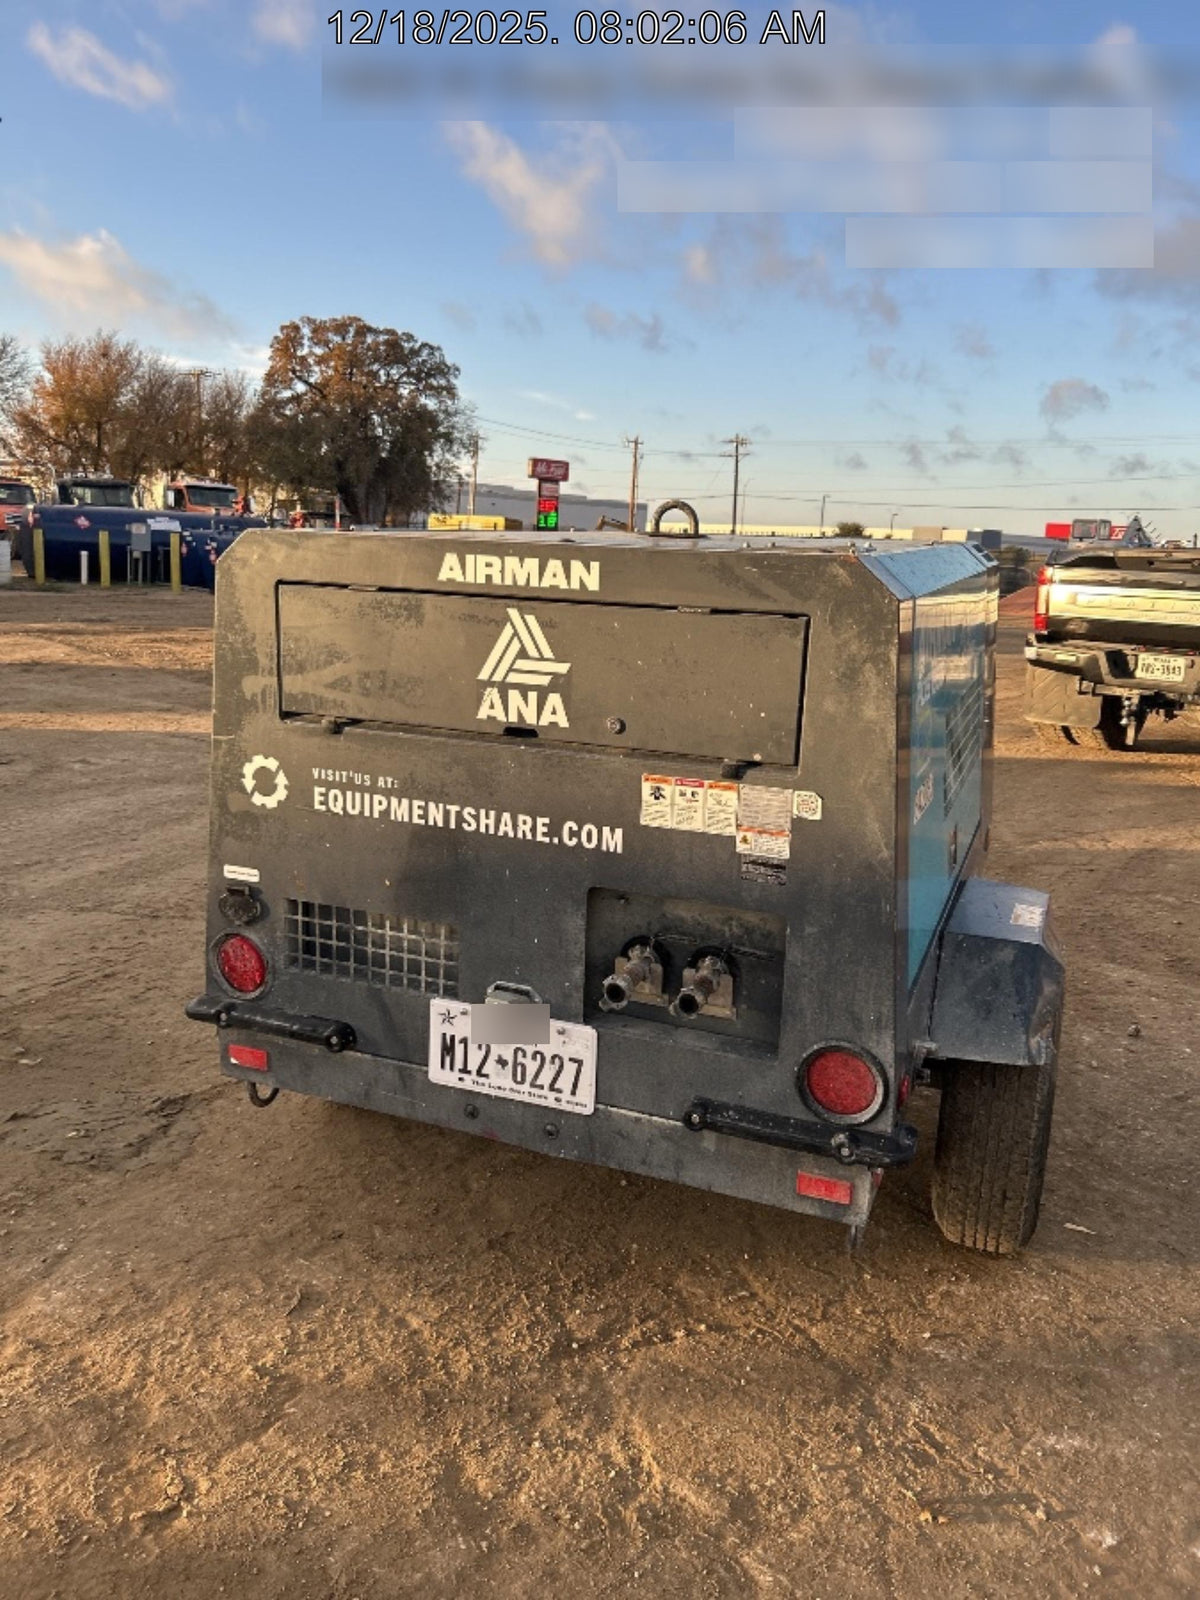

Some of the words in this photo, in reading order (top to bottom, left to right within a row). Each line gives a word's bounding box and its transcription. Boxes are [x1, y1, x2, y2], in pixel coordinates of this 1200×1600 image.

[437, 552, 600, 591] AIRMAN
[476, 687, 570, 728] ANA
[377, 776, 399, 788] AT:
[313, 785, 624, 854] EQUIPMENTSHARE.COM
[440, 1032, 492, 1080] M12
[511, 1046, 584, 1097] 6227
